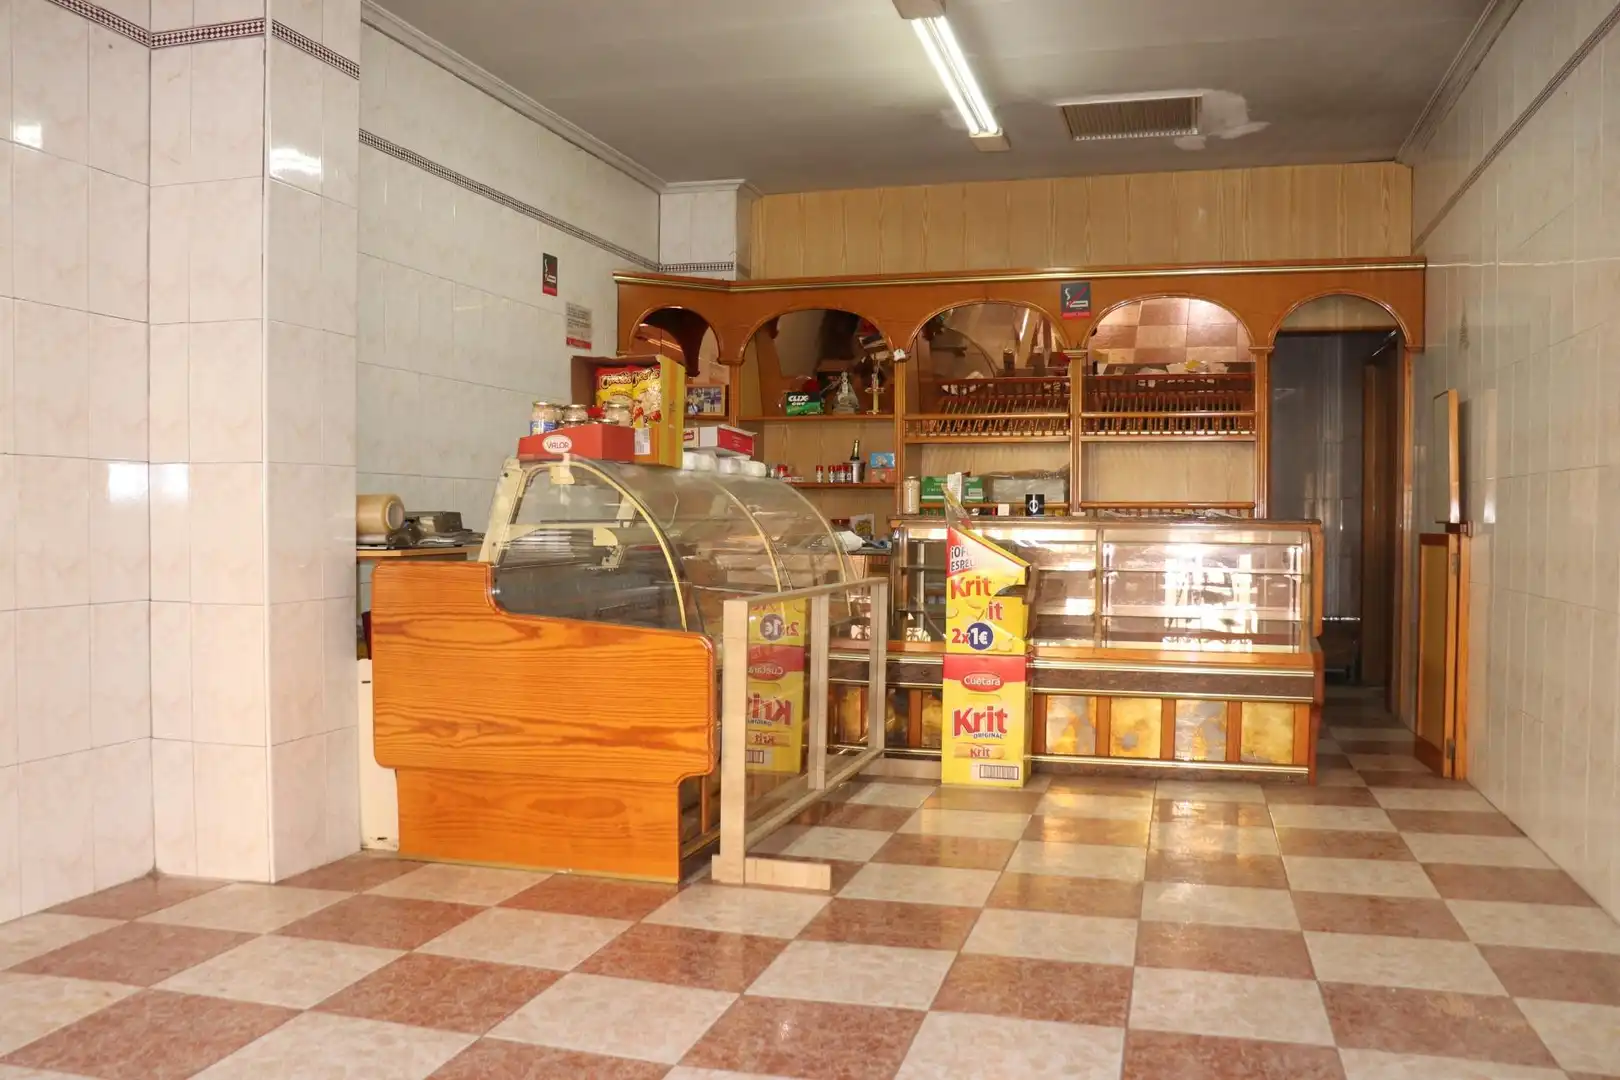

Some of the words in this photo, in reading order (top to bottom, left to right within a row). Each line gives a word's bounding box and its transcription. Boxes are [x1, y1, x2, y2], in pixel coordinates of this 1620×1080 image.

[950, 575, 993, 600] Krit
[953, 705, 1008, 737] Krit
[973, 732, 1004, 740] ORIGINAL
[970, 747, 991, 758] Krit
